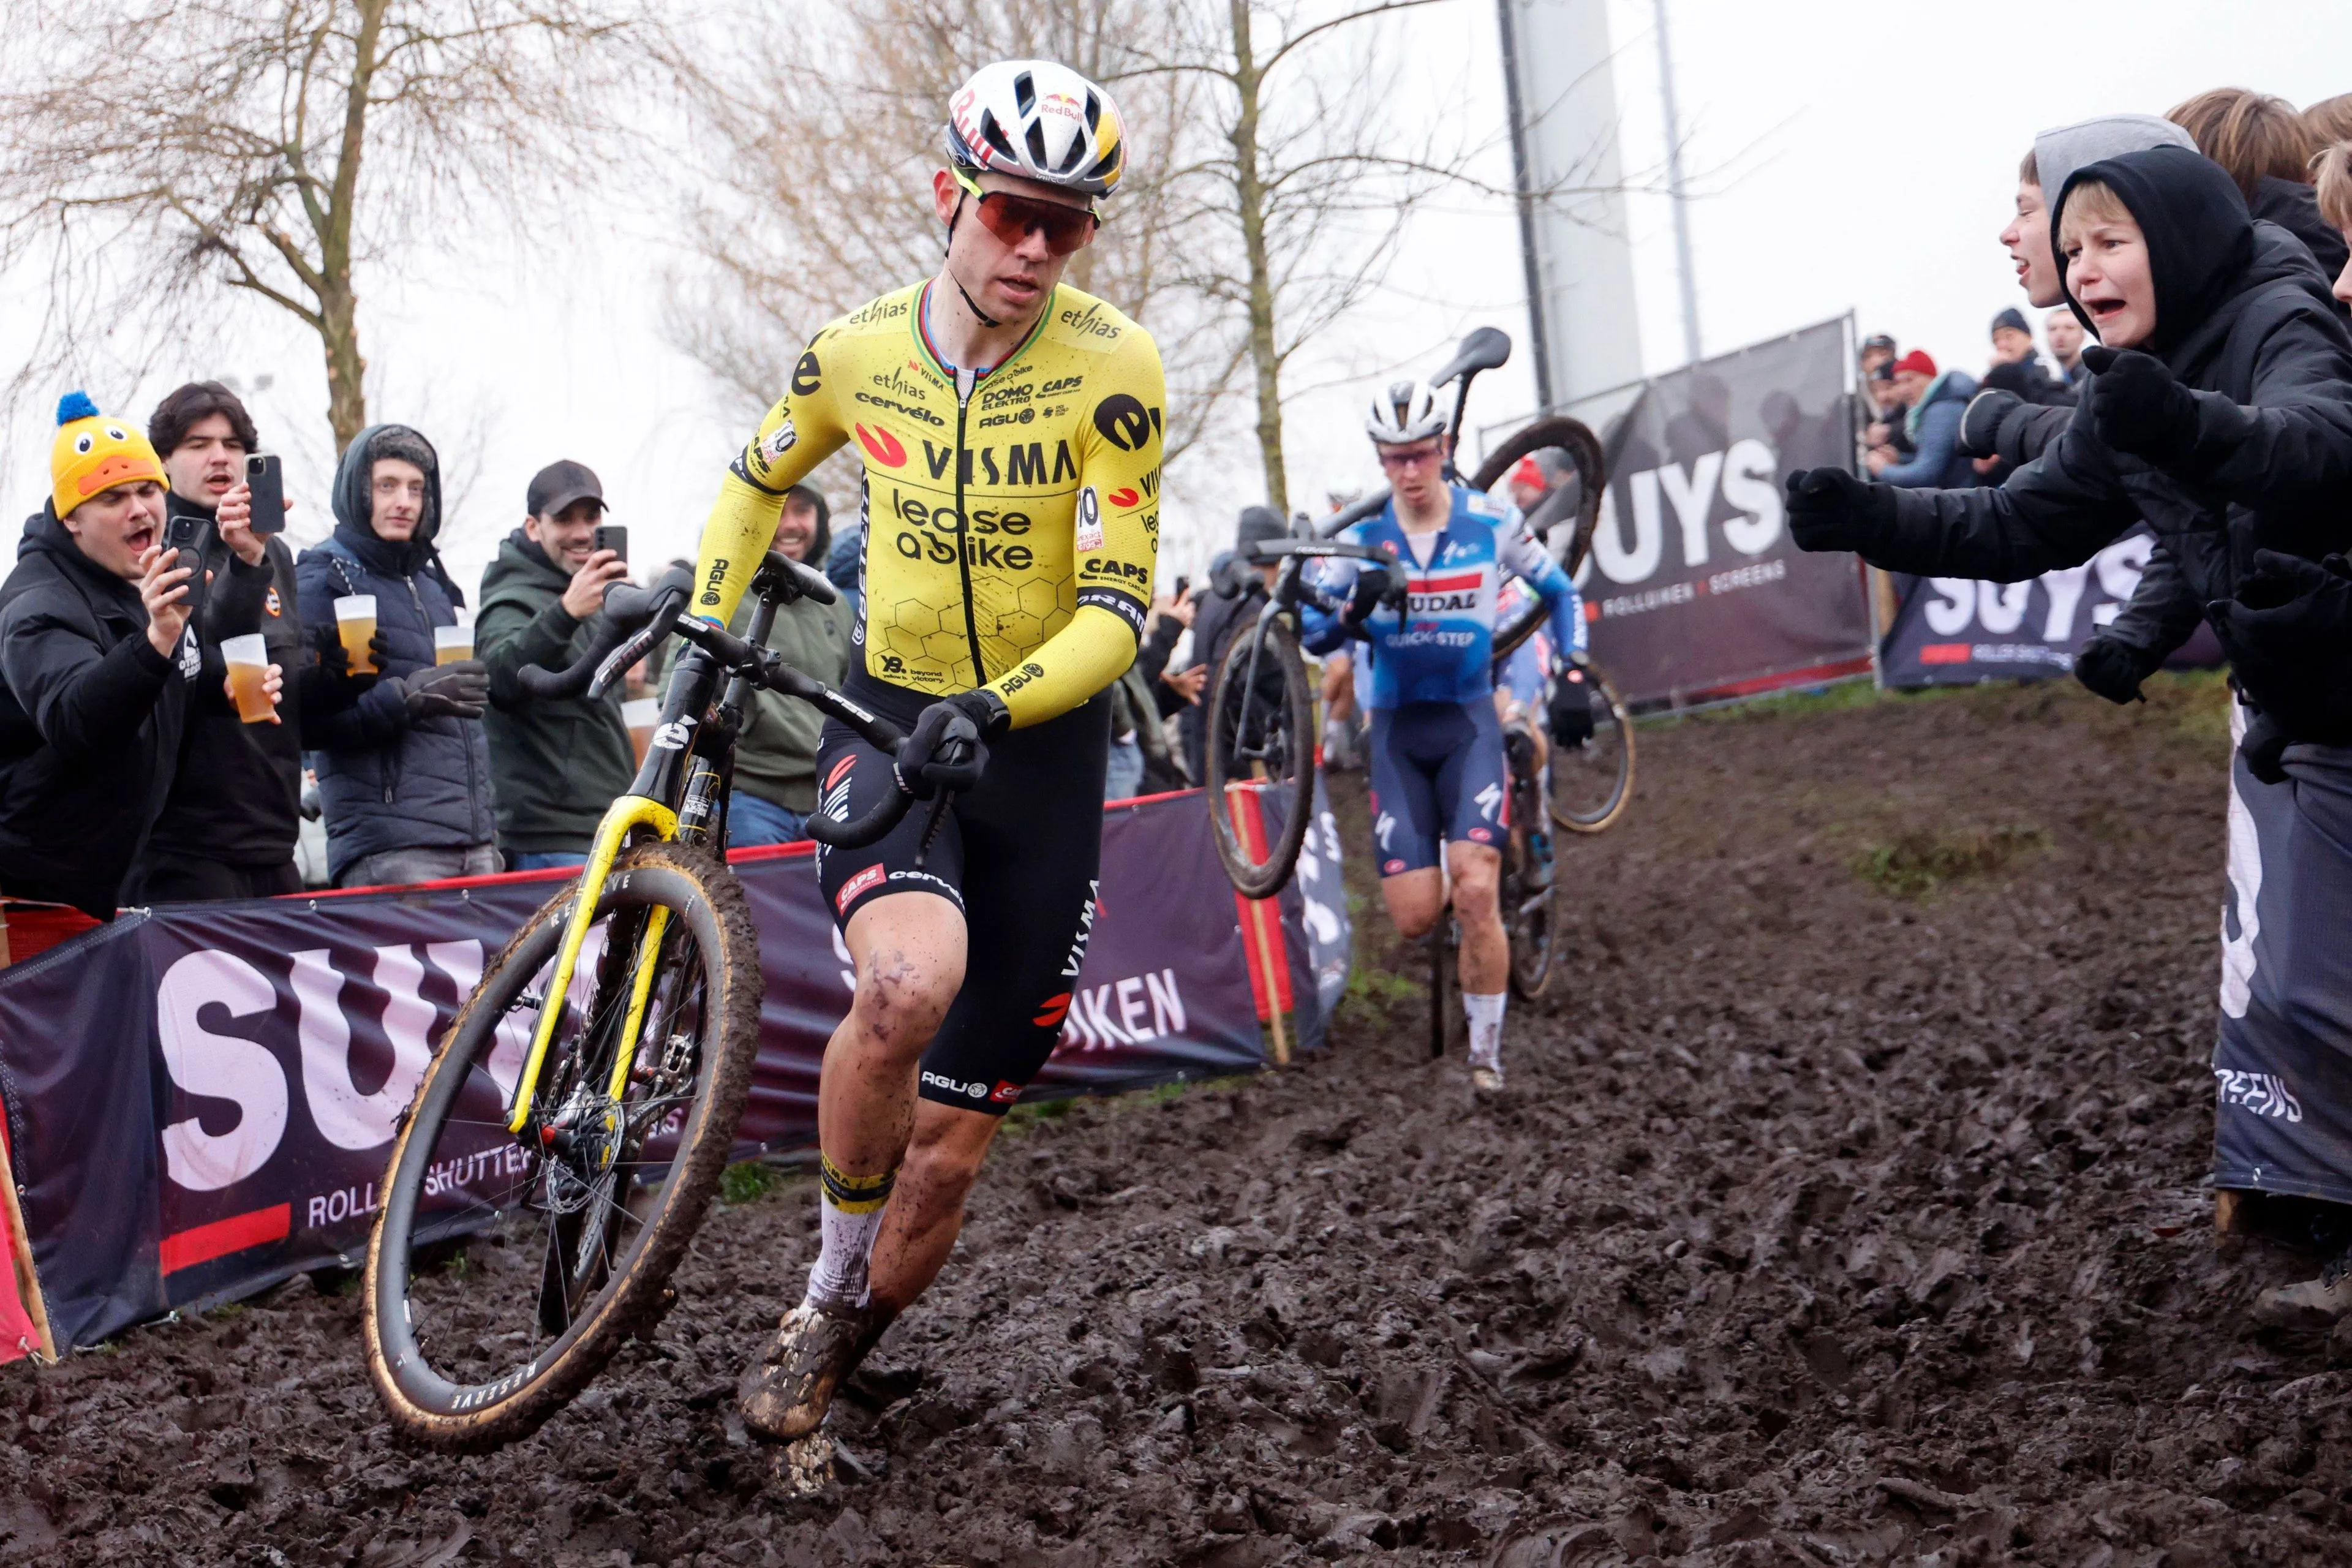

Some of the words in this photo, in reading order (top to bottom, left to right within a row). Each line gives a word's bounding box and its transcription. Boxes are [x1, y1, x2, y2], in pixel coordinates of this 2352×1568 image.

[1042, 104, 1063, 115] Red
[1065, 108, 1084, 122] Bull
[850, 296, 908, 326] ethias
[1060, 303, 1122, 339] ethias
[873, 366, 926, 400] ethias
[921, 368, 944, 391] VISMA
[1042, 375, 1084, 393] CAPS
[981, 396, 1031, 411] ELEKTRO
[982, 383, 1033, 405] DOMO
[855, 392, 945, 426] cervélo
[979, 413, 1019, 429] AGU
[922, 439, 1078, 486] VISMA
[893, 488, 1032, 536] lease
[859, 473, 870, 621] BETCIT
[706, 559, 730, 592] AGU
[1085, 558, 1148, 585] CAPS
[1100, 576, 1126, 586] ENERGY
[1383, 592, 1477, 612] UDAL
[910, 668, 943, 677] beyond
[1000, 670, 1032, 697] AGU
[841, 869, 877, 901] CAPS
[1061, 879, 1100, 977] VISMA
[921, 1070, 969, 1093] AGU
[308, 1181, 377, 1228] ROLL
[450, 1361, 537, 1409] RESERVE
